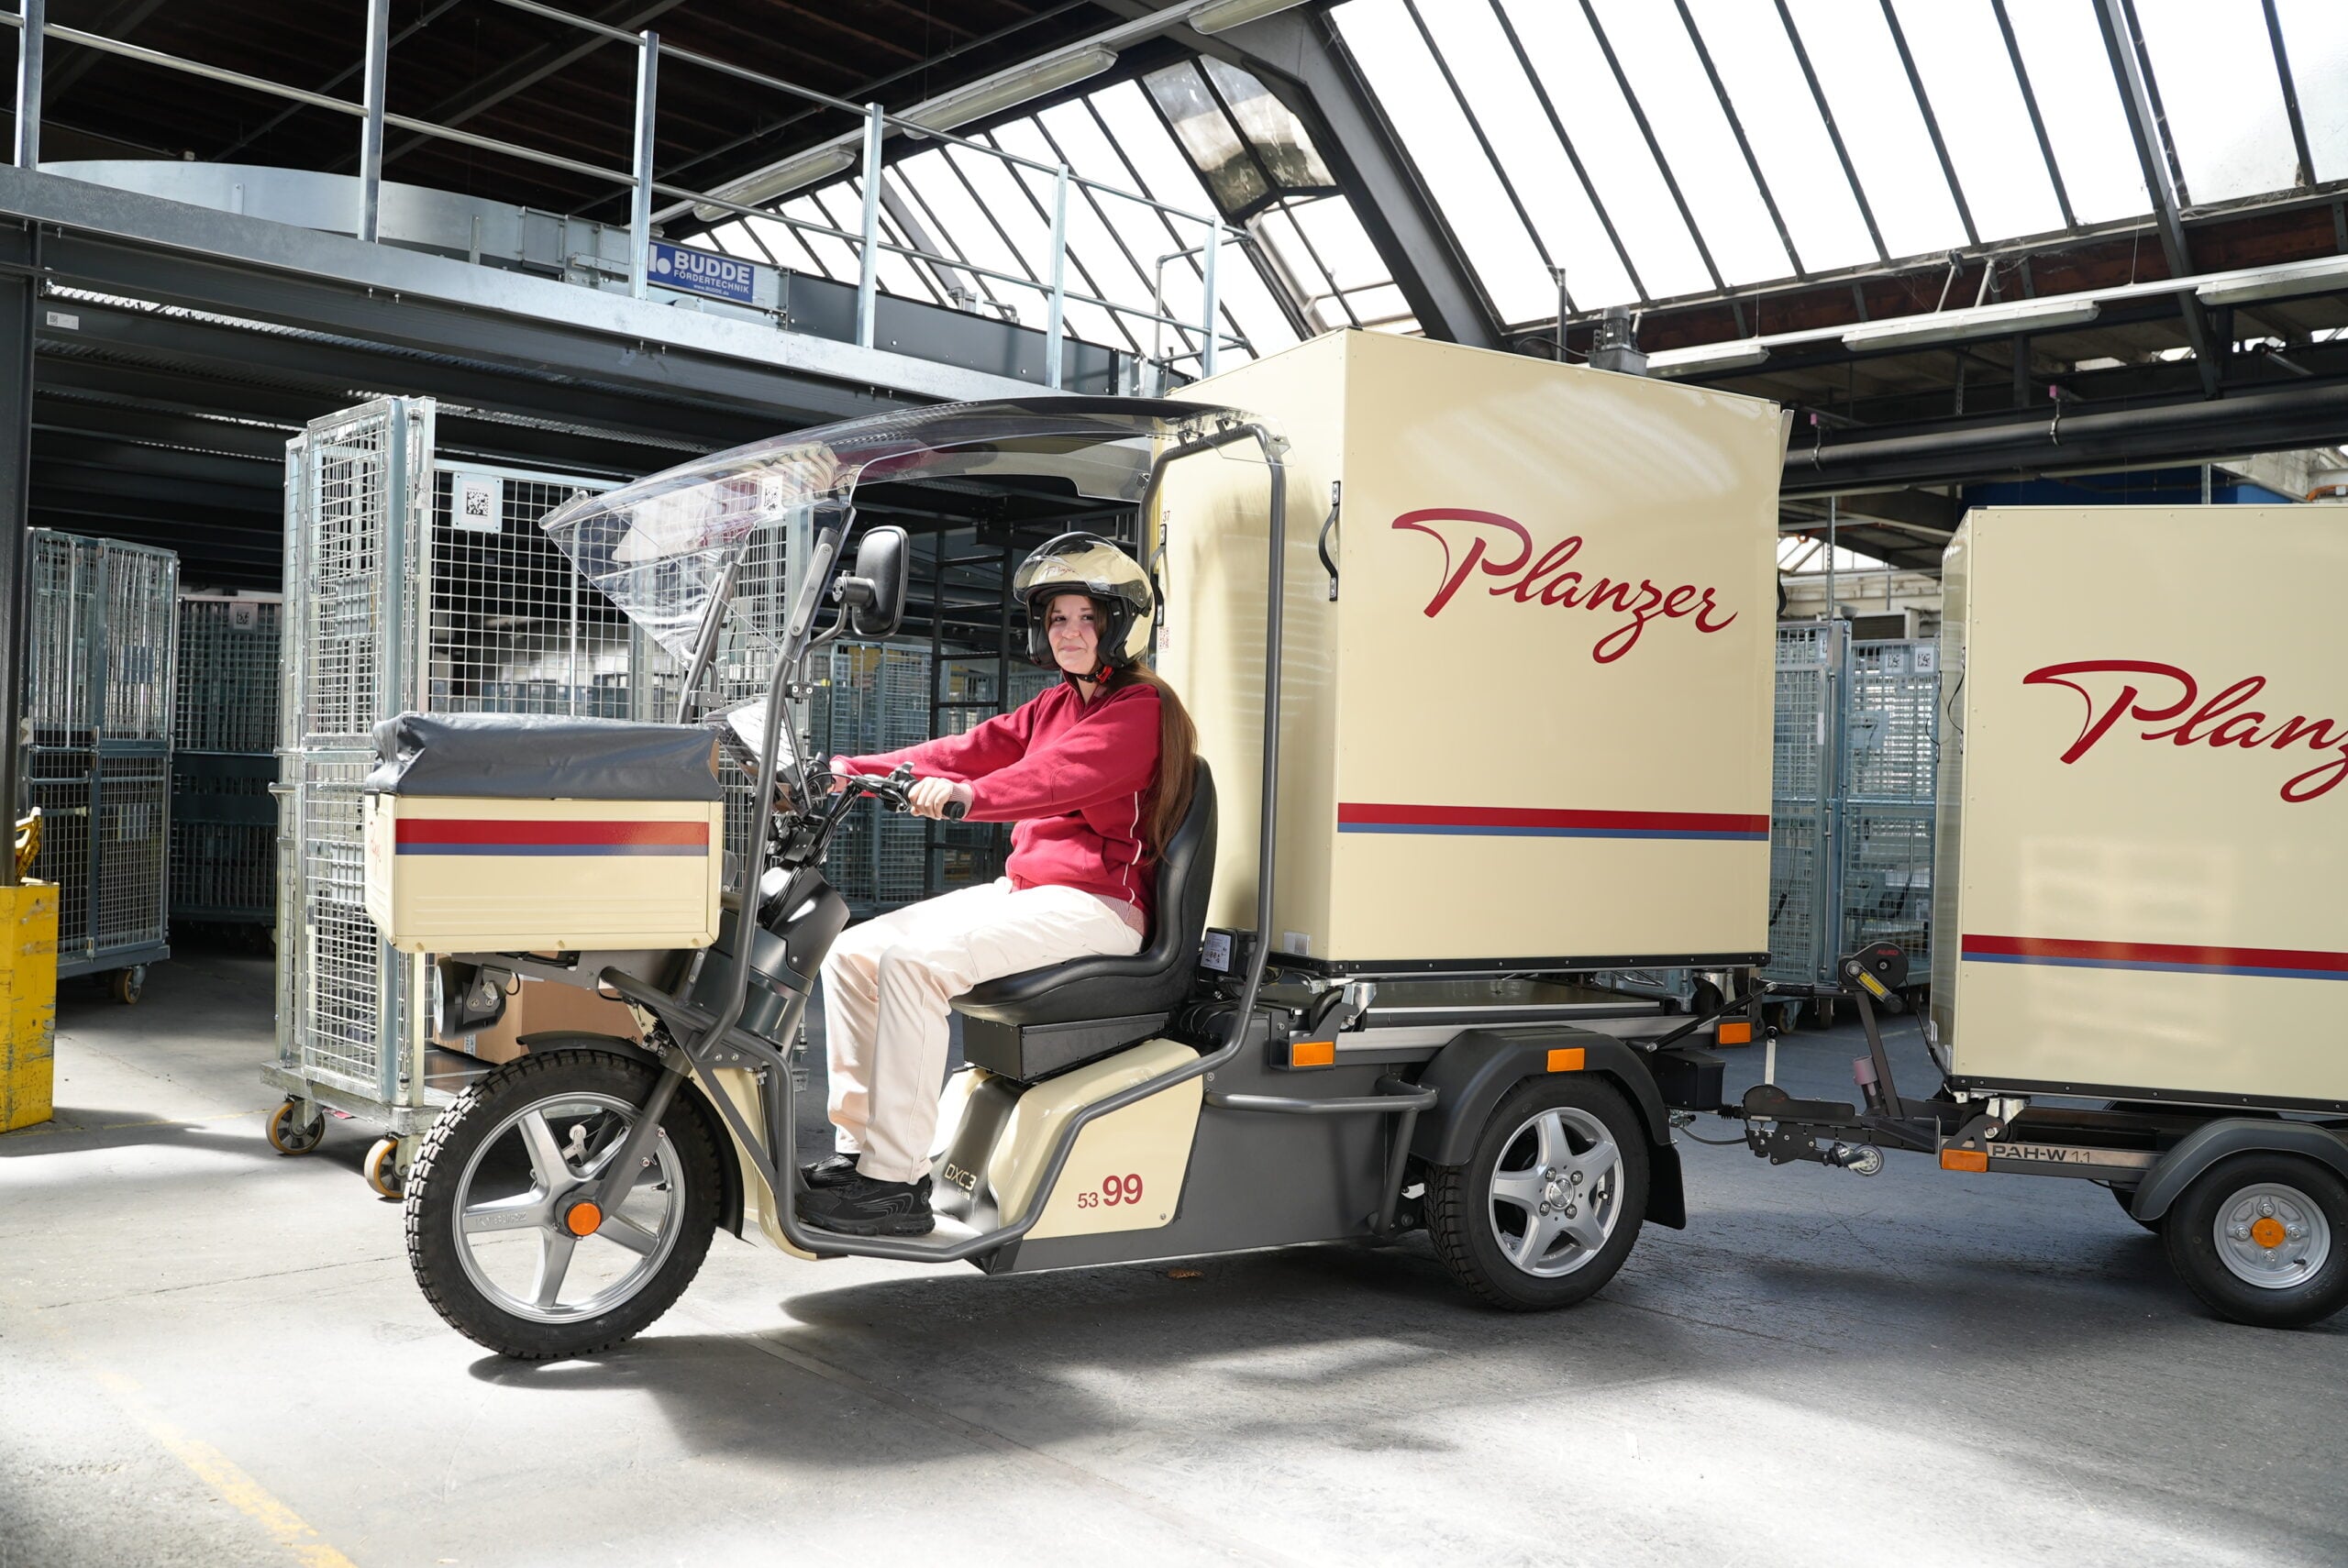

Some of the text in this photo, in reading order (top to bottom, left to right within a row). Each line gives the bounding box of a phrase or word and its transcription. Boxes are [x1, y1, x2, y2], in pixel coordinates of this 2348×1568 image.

[673, 269, 749, 294] FÖRDERTECHNIK
[674, 250, 750, 285] BUDDE
[1391, 507, 1738, 664] Planzer
[1992, 1144, 2067, 1162] PAH-W
[944, 1163, 977, 1191] DXC3
[1102, 1173, 1144, 1207] 99
